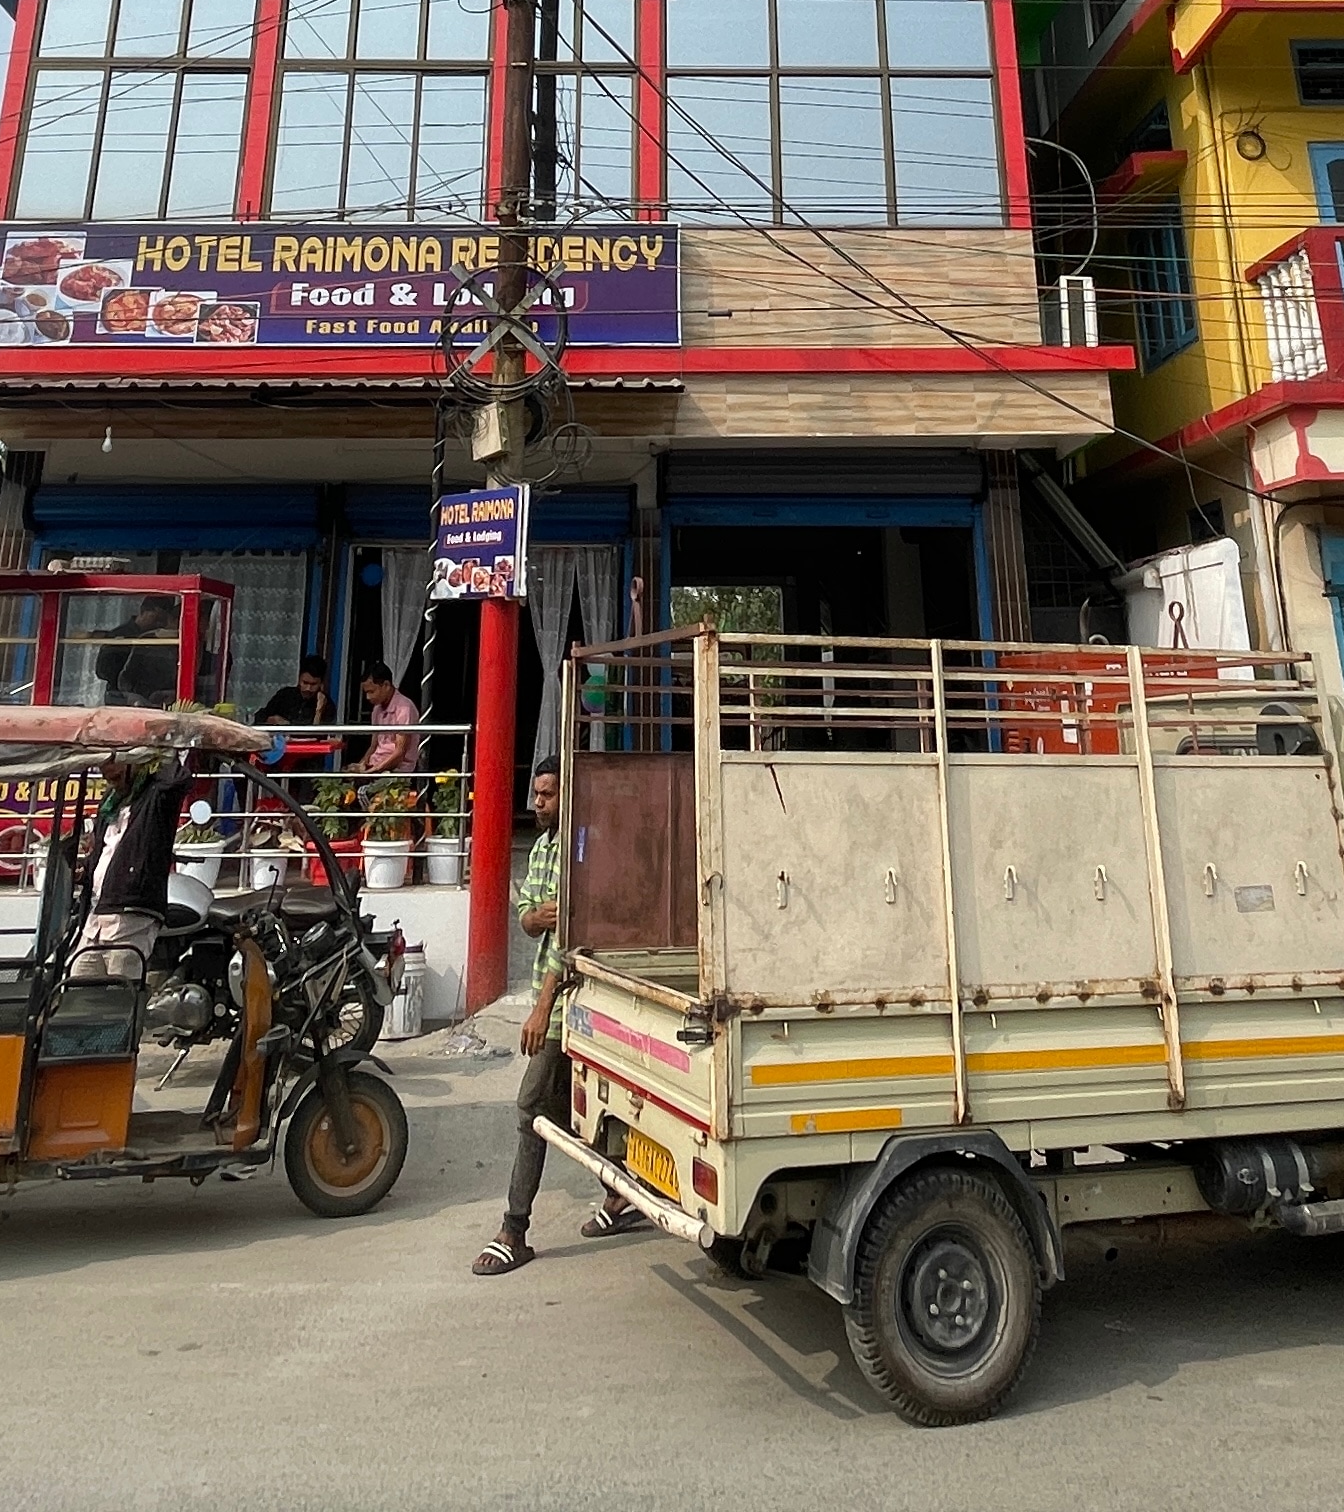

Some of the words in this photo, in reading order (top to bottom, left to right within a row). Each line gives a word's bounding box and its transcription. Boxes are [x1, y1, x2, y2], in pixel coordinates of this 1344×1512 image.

[136, 235, 263, 273] HOTEL
[272, 235, 443, 273] RAIMONA
[452, 235, 663, 272] REIDENCY
[290, 282, 375, 307] Food
[389, 282, 418, 307] &
[306, 318, 357, 335] Fast
[367, 318, 420, 335] Food
[440, 502, 470, 526] HOTEL
[471, 498, 515, 522] RAIMONA
[446, 531, 464, 545] Food
[465, 531, 471, 543] &
[472, 529, 502, 544] Lodging
[14, 779, 31, 802] &
